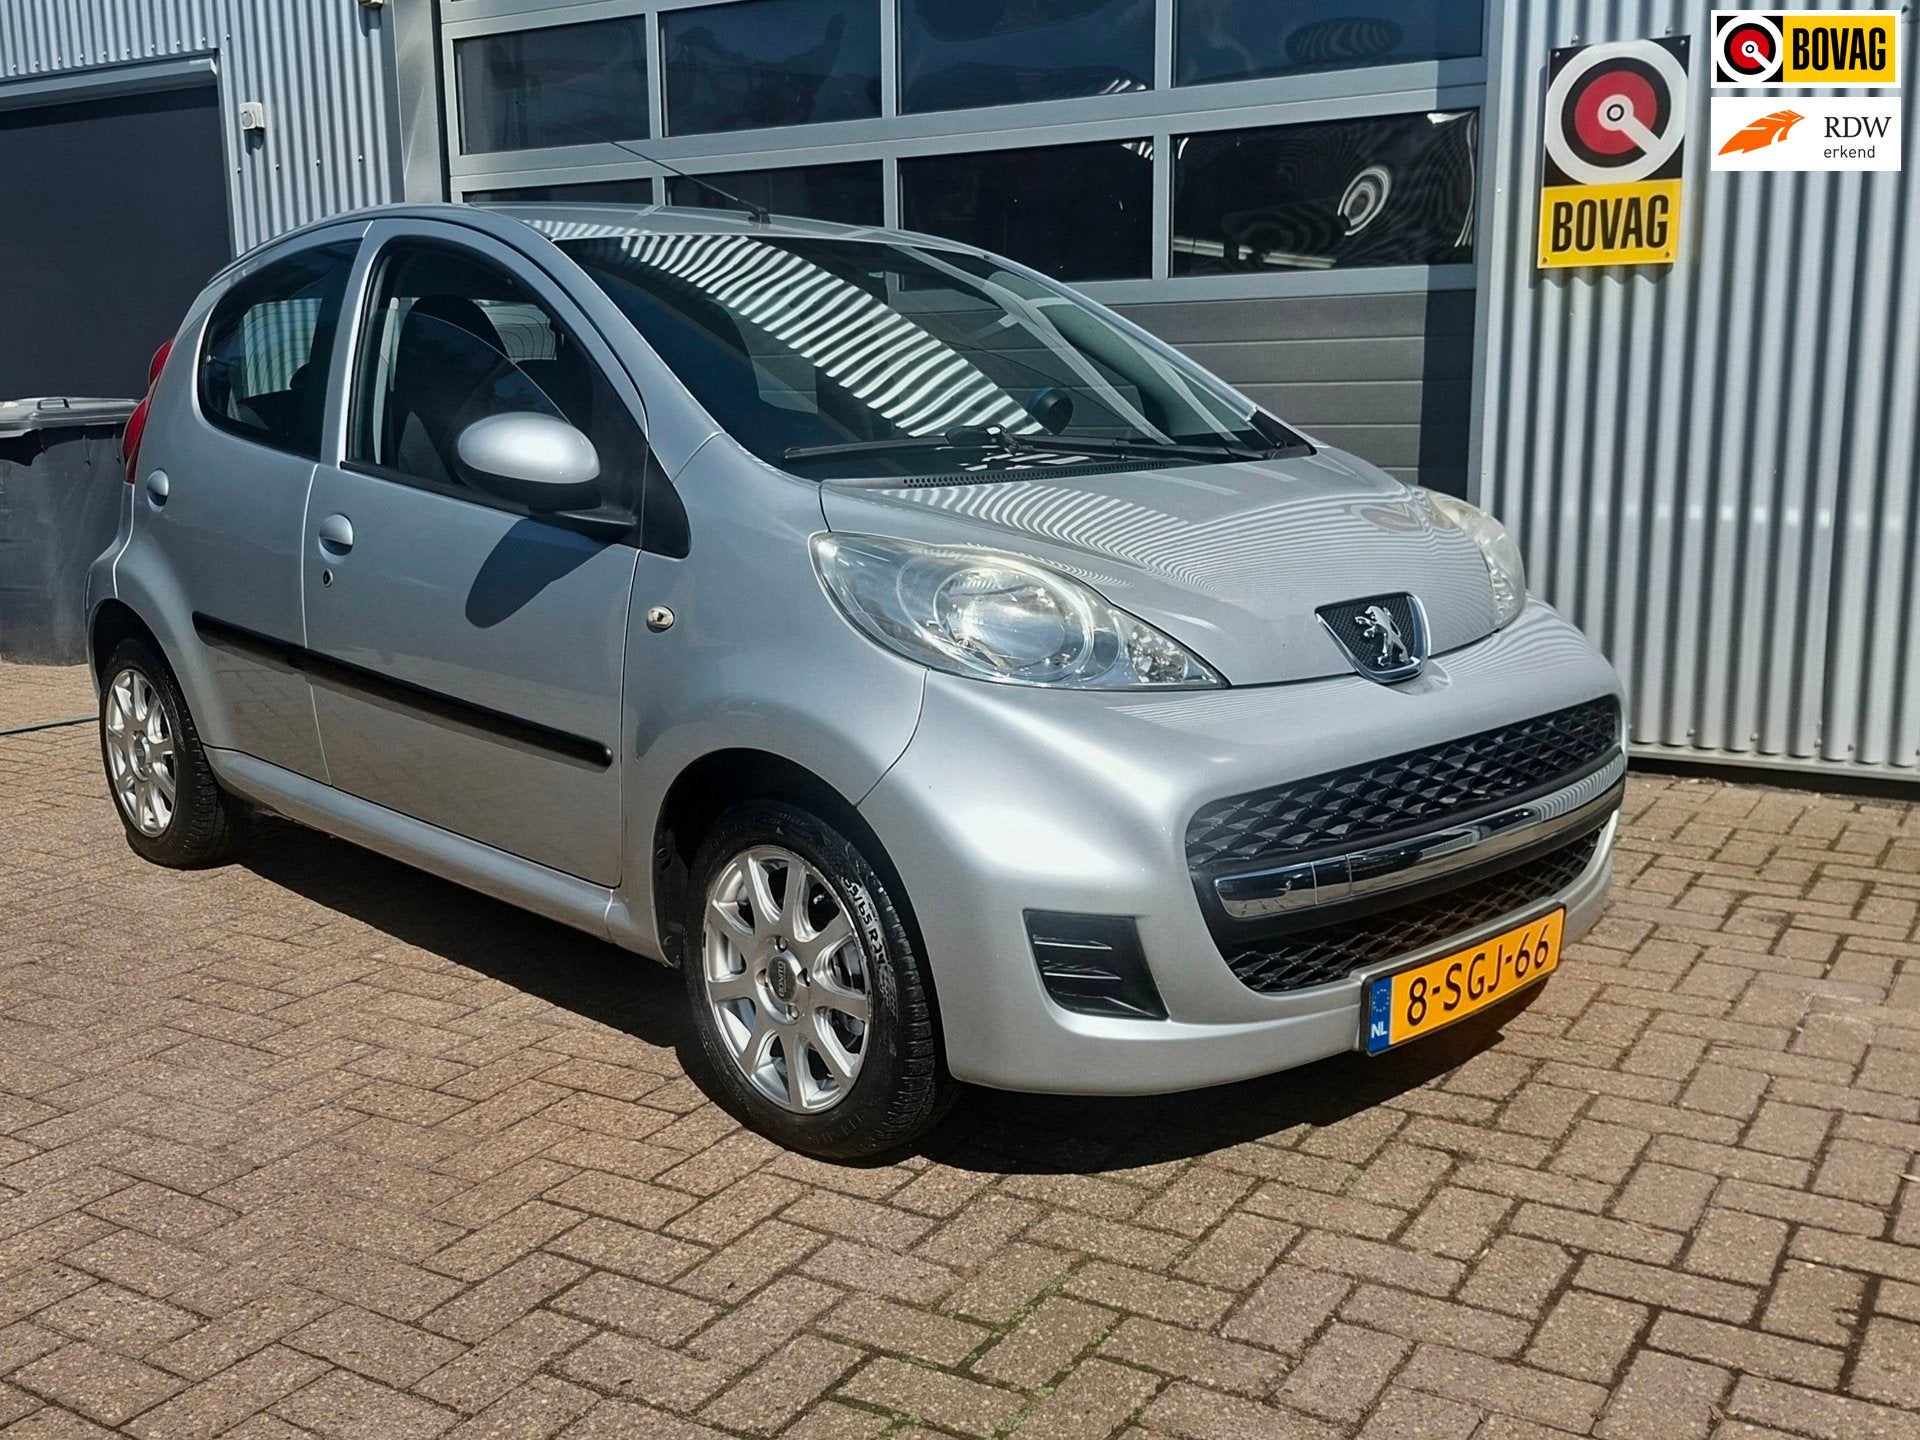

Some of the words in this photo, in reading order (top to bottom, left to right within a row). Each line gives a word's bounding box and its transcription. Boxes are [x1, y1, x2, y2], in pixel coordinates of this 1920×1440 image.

[1551, 194, 1670, 253] BOVAG
[1406, 923, 1550, 1027] 8-SGJ-66
[1371, 1021, 1388, 1039] NL
